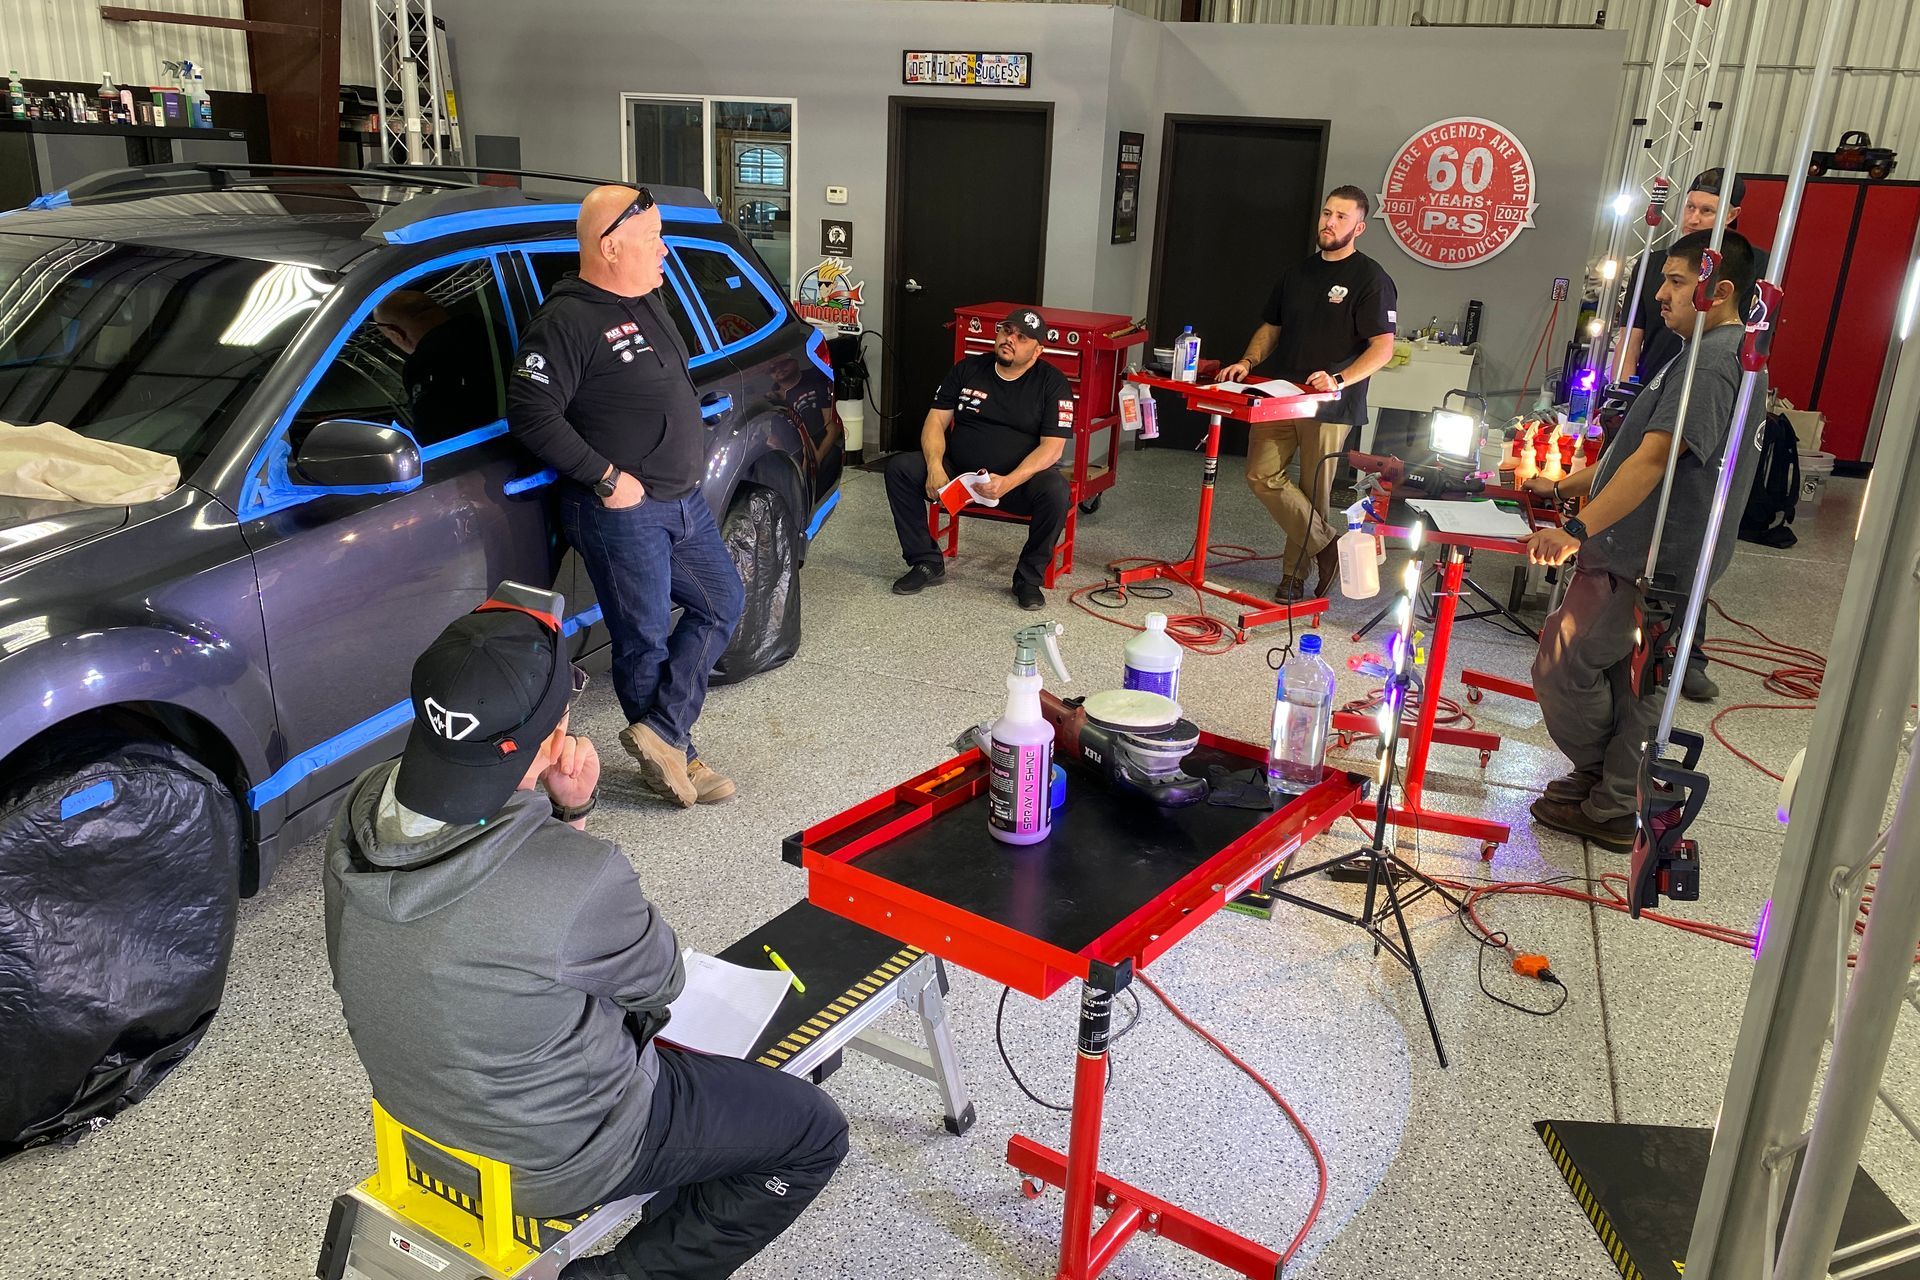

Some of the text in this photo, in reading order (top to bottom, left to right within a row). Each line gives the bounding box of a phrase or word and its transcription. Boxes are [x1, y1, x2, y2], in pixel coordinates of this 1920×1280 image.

[912, 61, 1020, 80] DETAILING SUCCESS
[1390, 125, 1527, 201] WHERE LEGENDS ARE MADE
[1426, 145, 1494, 194] 60
[1386, 201, 1412, 214] 1961
[1428, 193, 1484, 209] YEARS
[1423, 211, 1484, 234] P&S
[1497, 208, 1524, 220] 2021
[1395, 219, 1510, 261] DETAIL PRODUCTS
[1084, 745, 1102, 764] FLEX
[1023, 751, 1035, 830] SPRAY N SHINE
